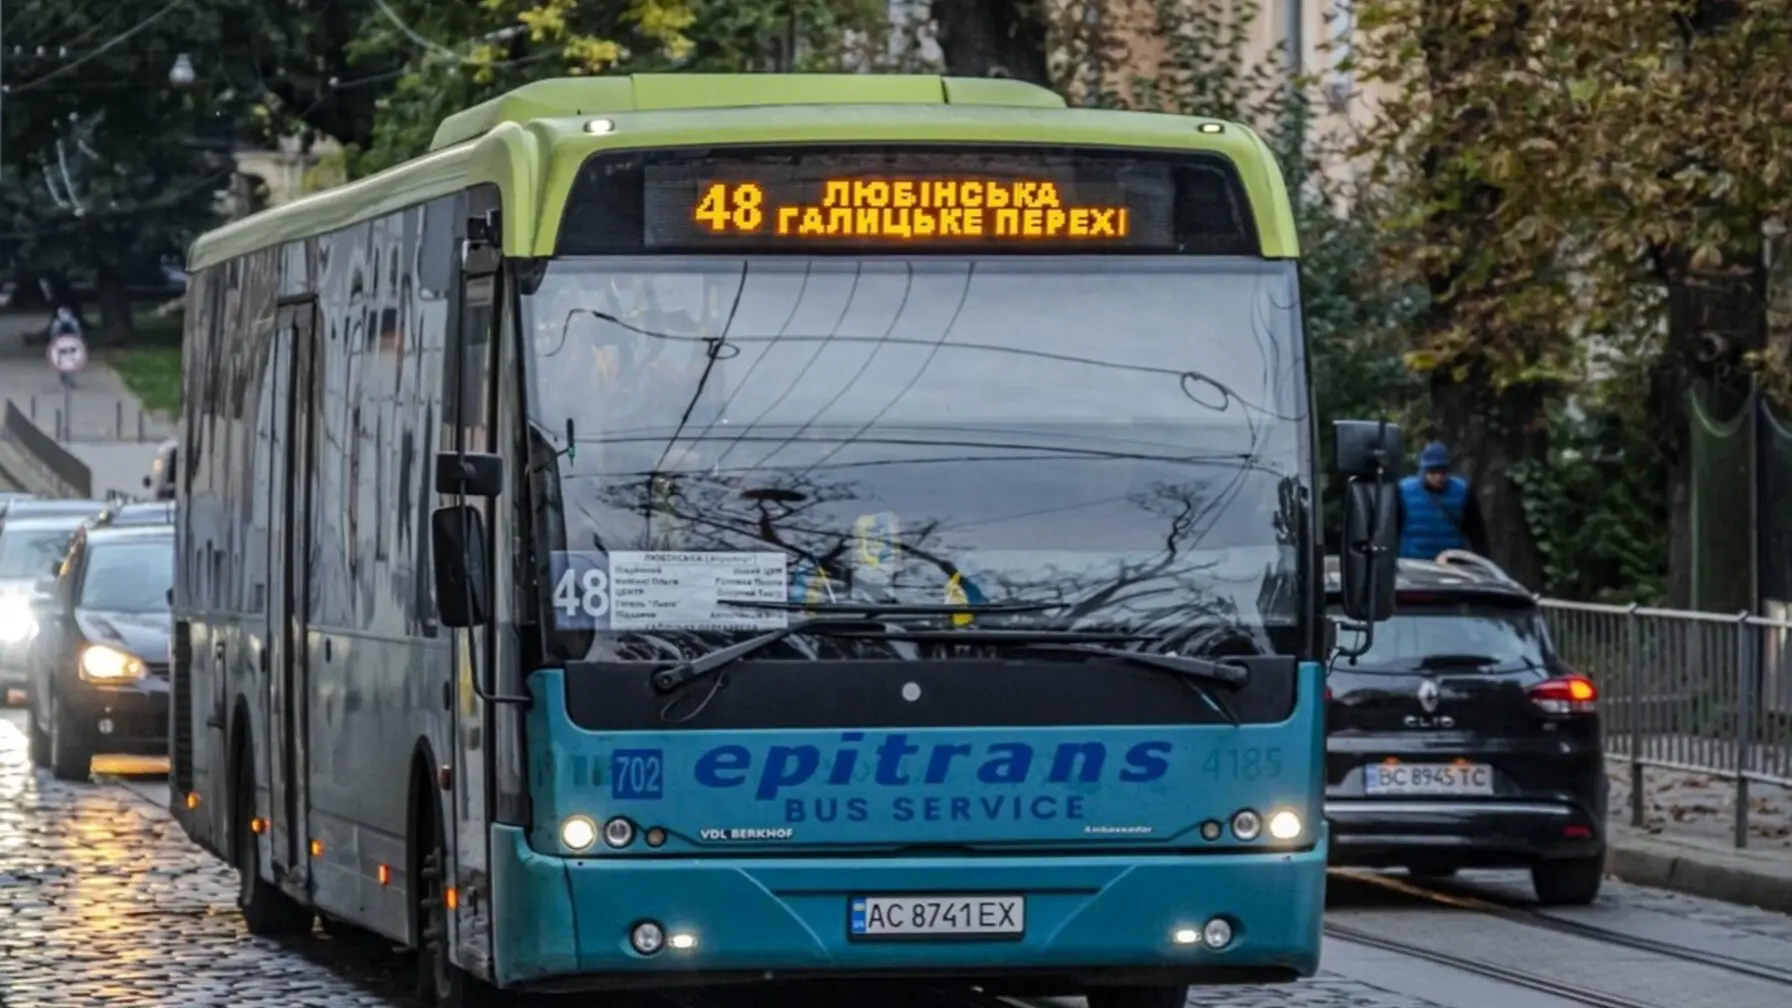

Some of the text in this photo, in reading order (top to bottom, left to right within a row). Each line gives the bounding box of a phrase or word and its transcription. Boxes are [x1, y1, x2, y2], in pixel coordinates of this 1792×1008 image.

[695, 183, 763, 230] 48
[823, 180, 1060, 208] ЛЮБІНСЬКА
[777, 207, 983, 238] ГАЛИЦЬКЕ
[552, 568, 609, 617] 48
[615, 755, 661, 793] 702
[694, 732, 1172, 801] epitrans
[1203, 747, 1283, 782] 4185
[1379, 768, 1486, 787] BC 8945 TC
[785, 795, 1085, 823] BUS SERVICE
[700, 827, 794, 840] VDL BERKHOF
[868, 903, 904, 929] AC
[911, 902, 972, 928] 8741
[978, 901, 1016, 927] EX
